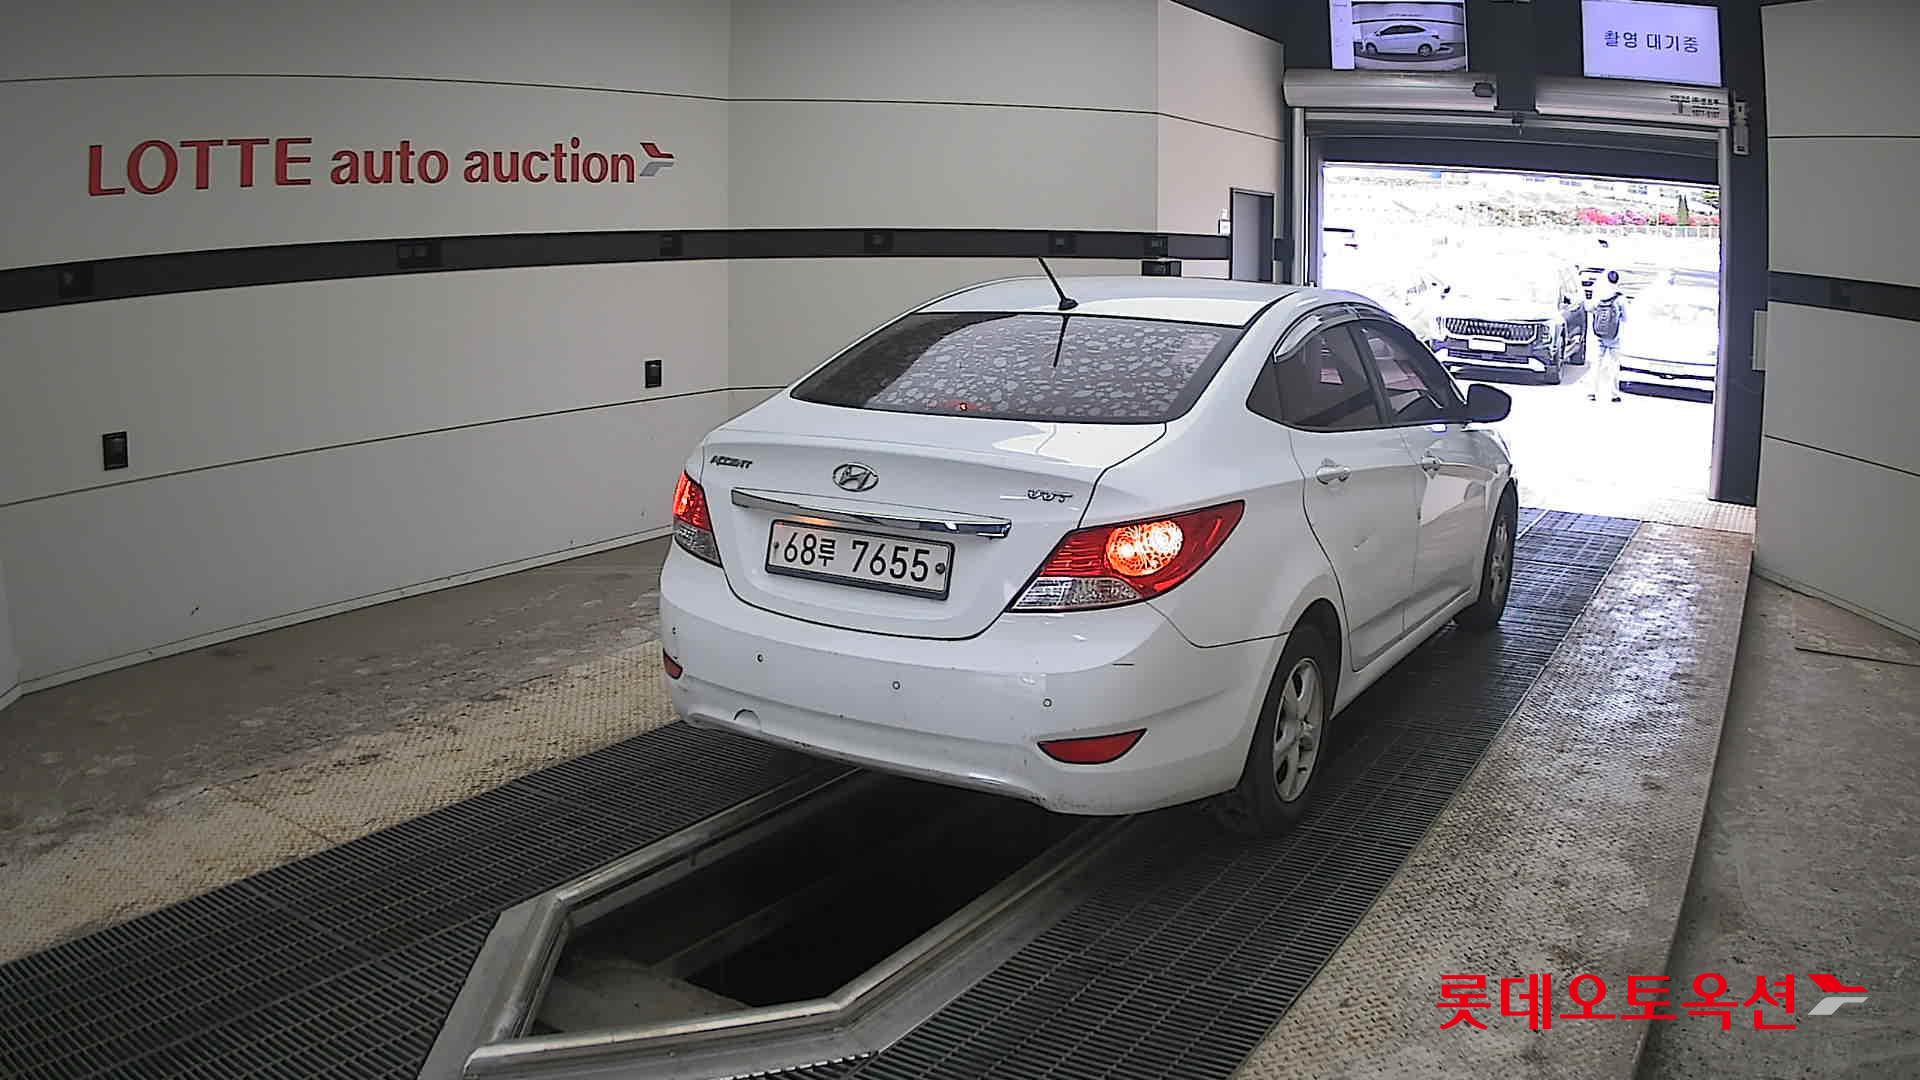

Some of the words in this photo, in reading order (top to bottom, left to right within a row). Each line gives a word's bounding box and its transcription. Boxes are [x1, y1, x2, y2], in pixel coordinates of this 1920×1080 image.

[1604, 29, 1638, 49] 촬영
[1646, 33, 1699, 53] 대기중
[87, 137, 312, 197] LOTTE
[331, 140, 449, 185] auto
[464, 136, 635, 185] auction
[783, 532, 836, 567] 68루
[852, 540, 930, 582] 7655
